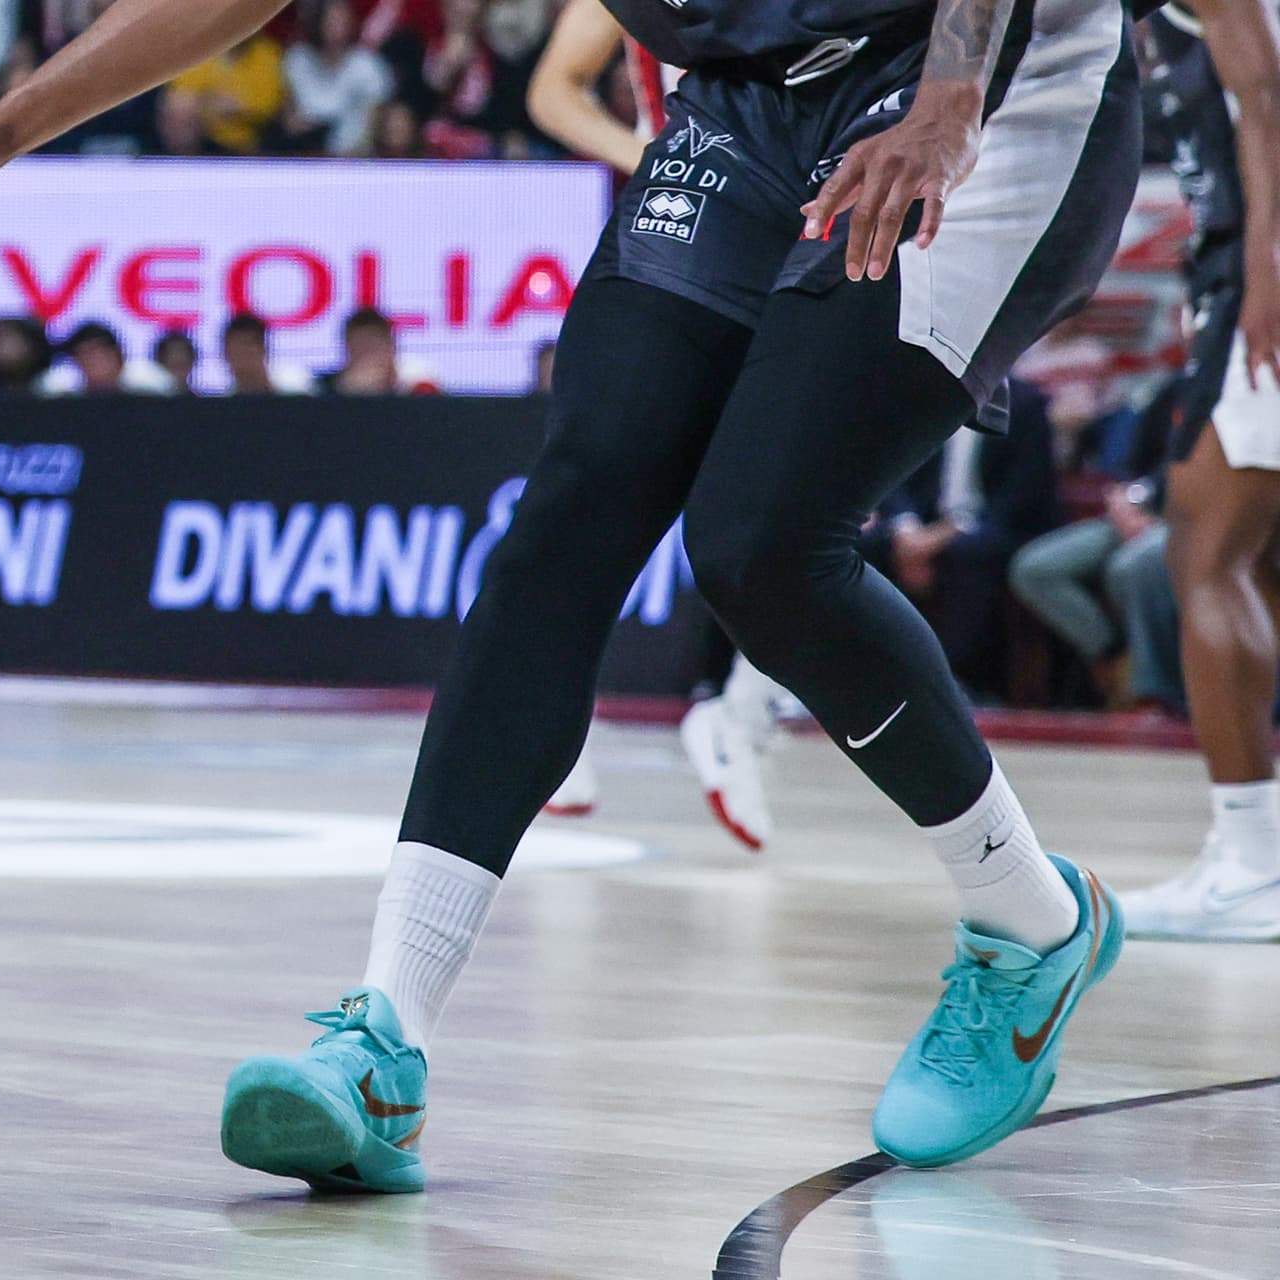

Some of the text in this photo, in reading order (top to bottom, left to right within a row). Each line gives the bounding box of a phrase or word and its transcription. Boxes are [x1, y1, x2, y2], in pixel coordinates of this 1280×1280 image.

[649, 158, 729, 193] VOI DI
[148, 499, 466, 619] DIVANI
